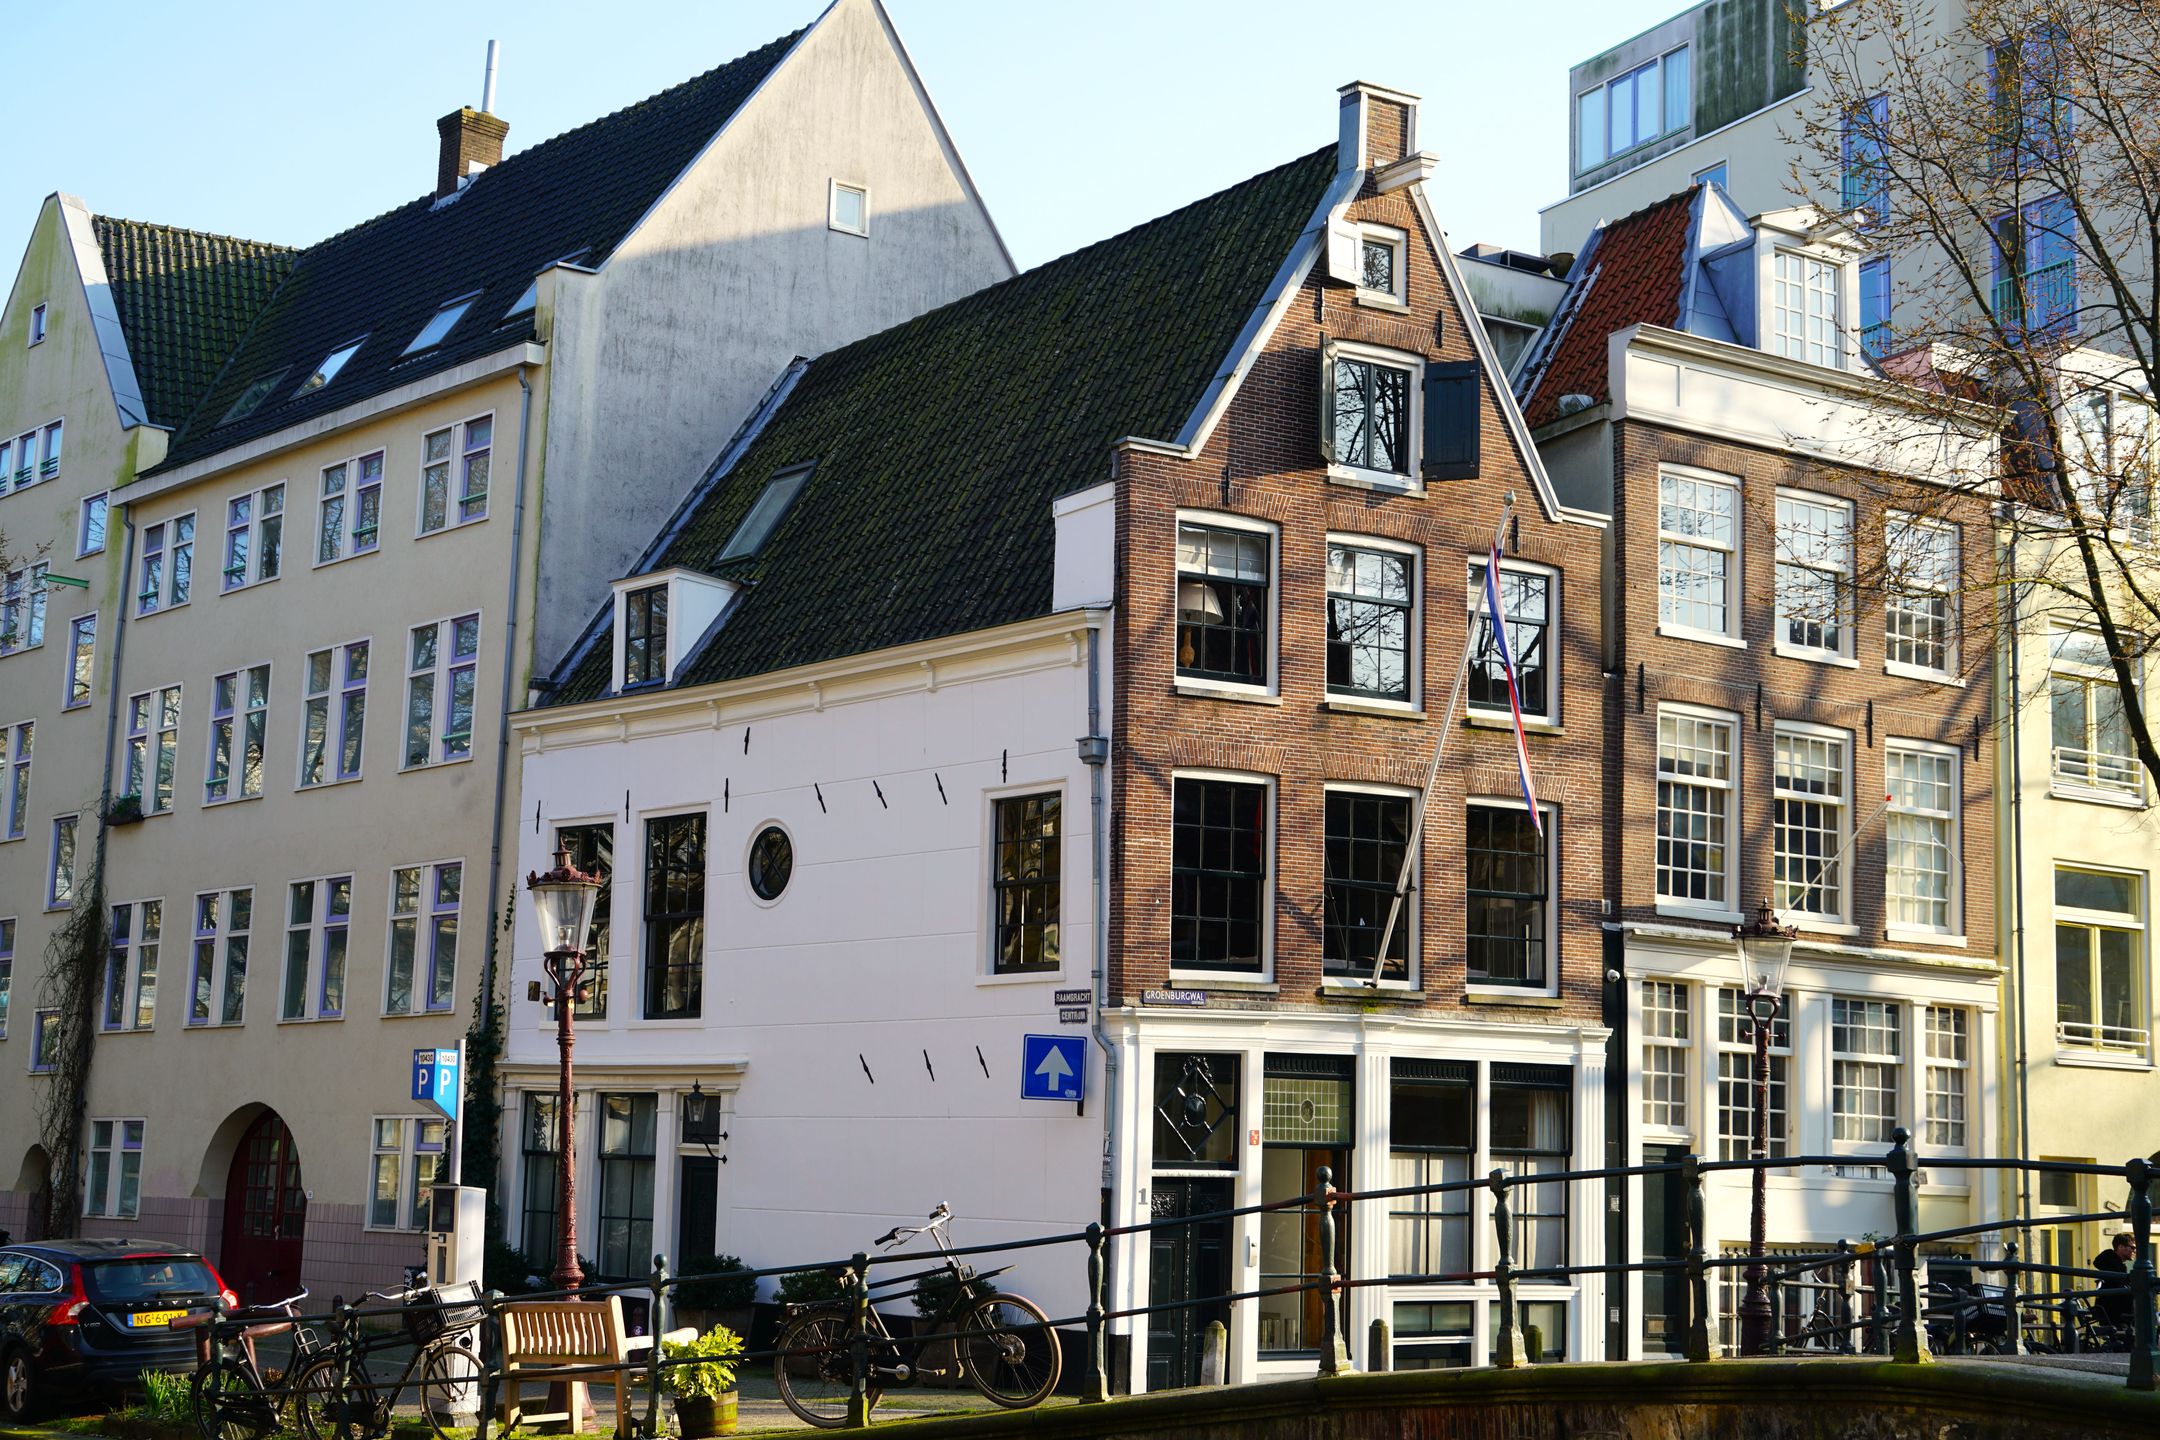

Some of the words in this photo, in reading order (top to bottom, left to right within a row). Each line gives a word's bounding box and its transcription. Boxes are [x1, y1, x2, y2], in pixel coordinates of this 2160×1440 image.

[1145, 990, 1204, 1001] GROENBURGWAL
[418, 1068, 428, 1095] P
[440, 1068, 451, 1096] P
[1138, 1187, 1148, 1205] 1
